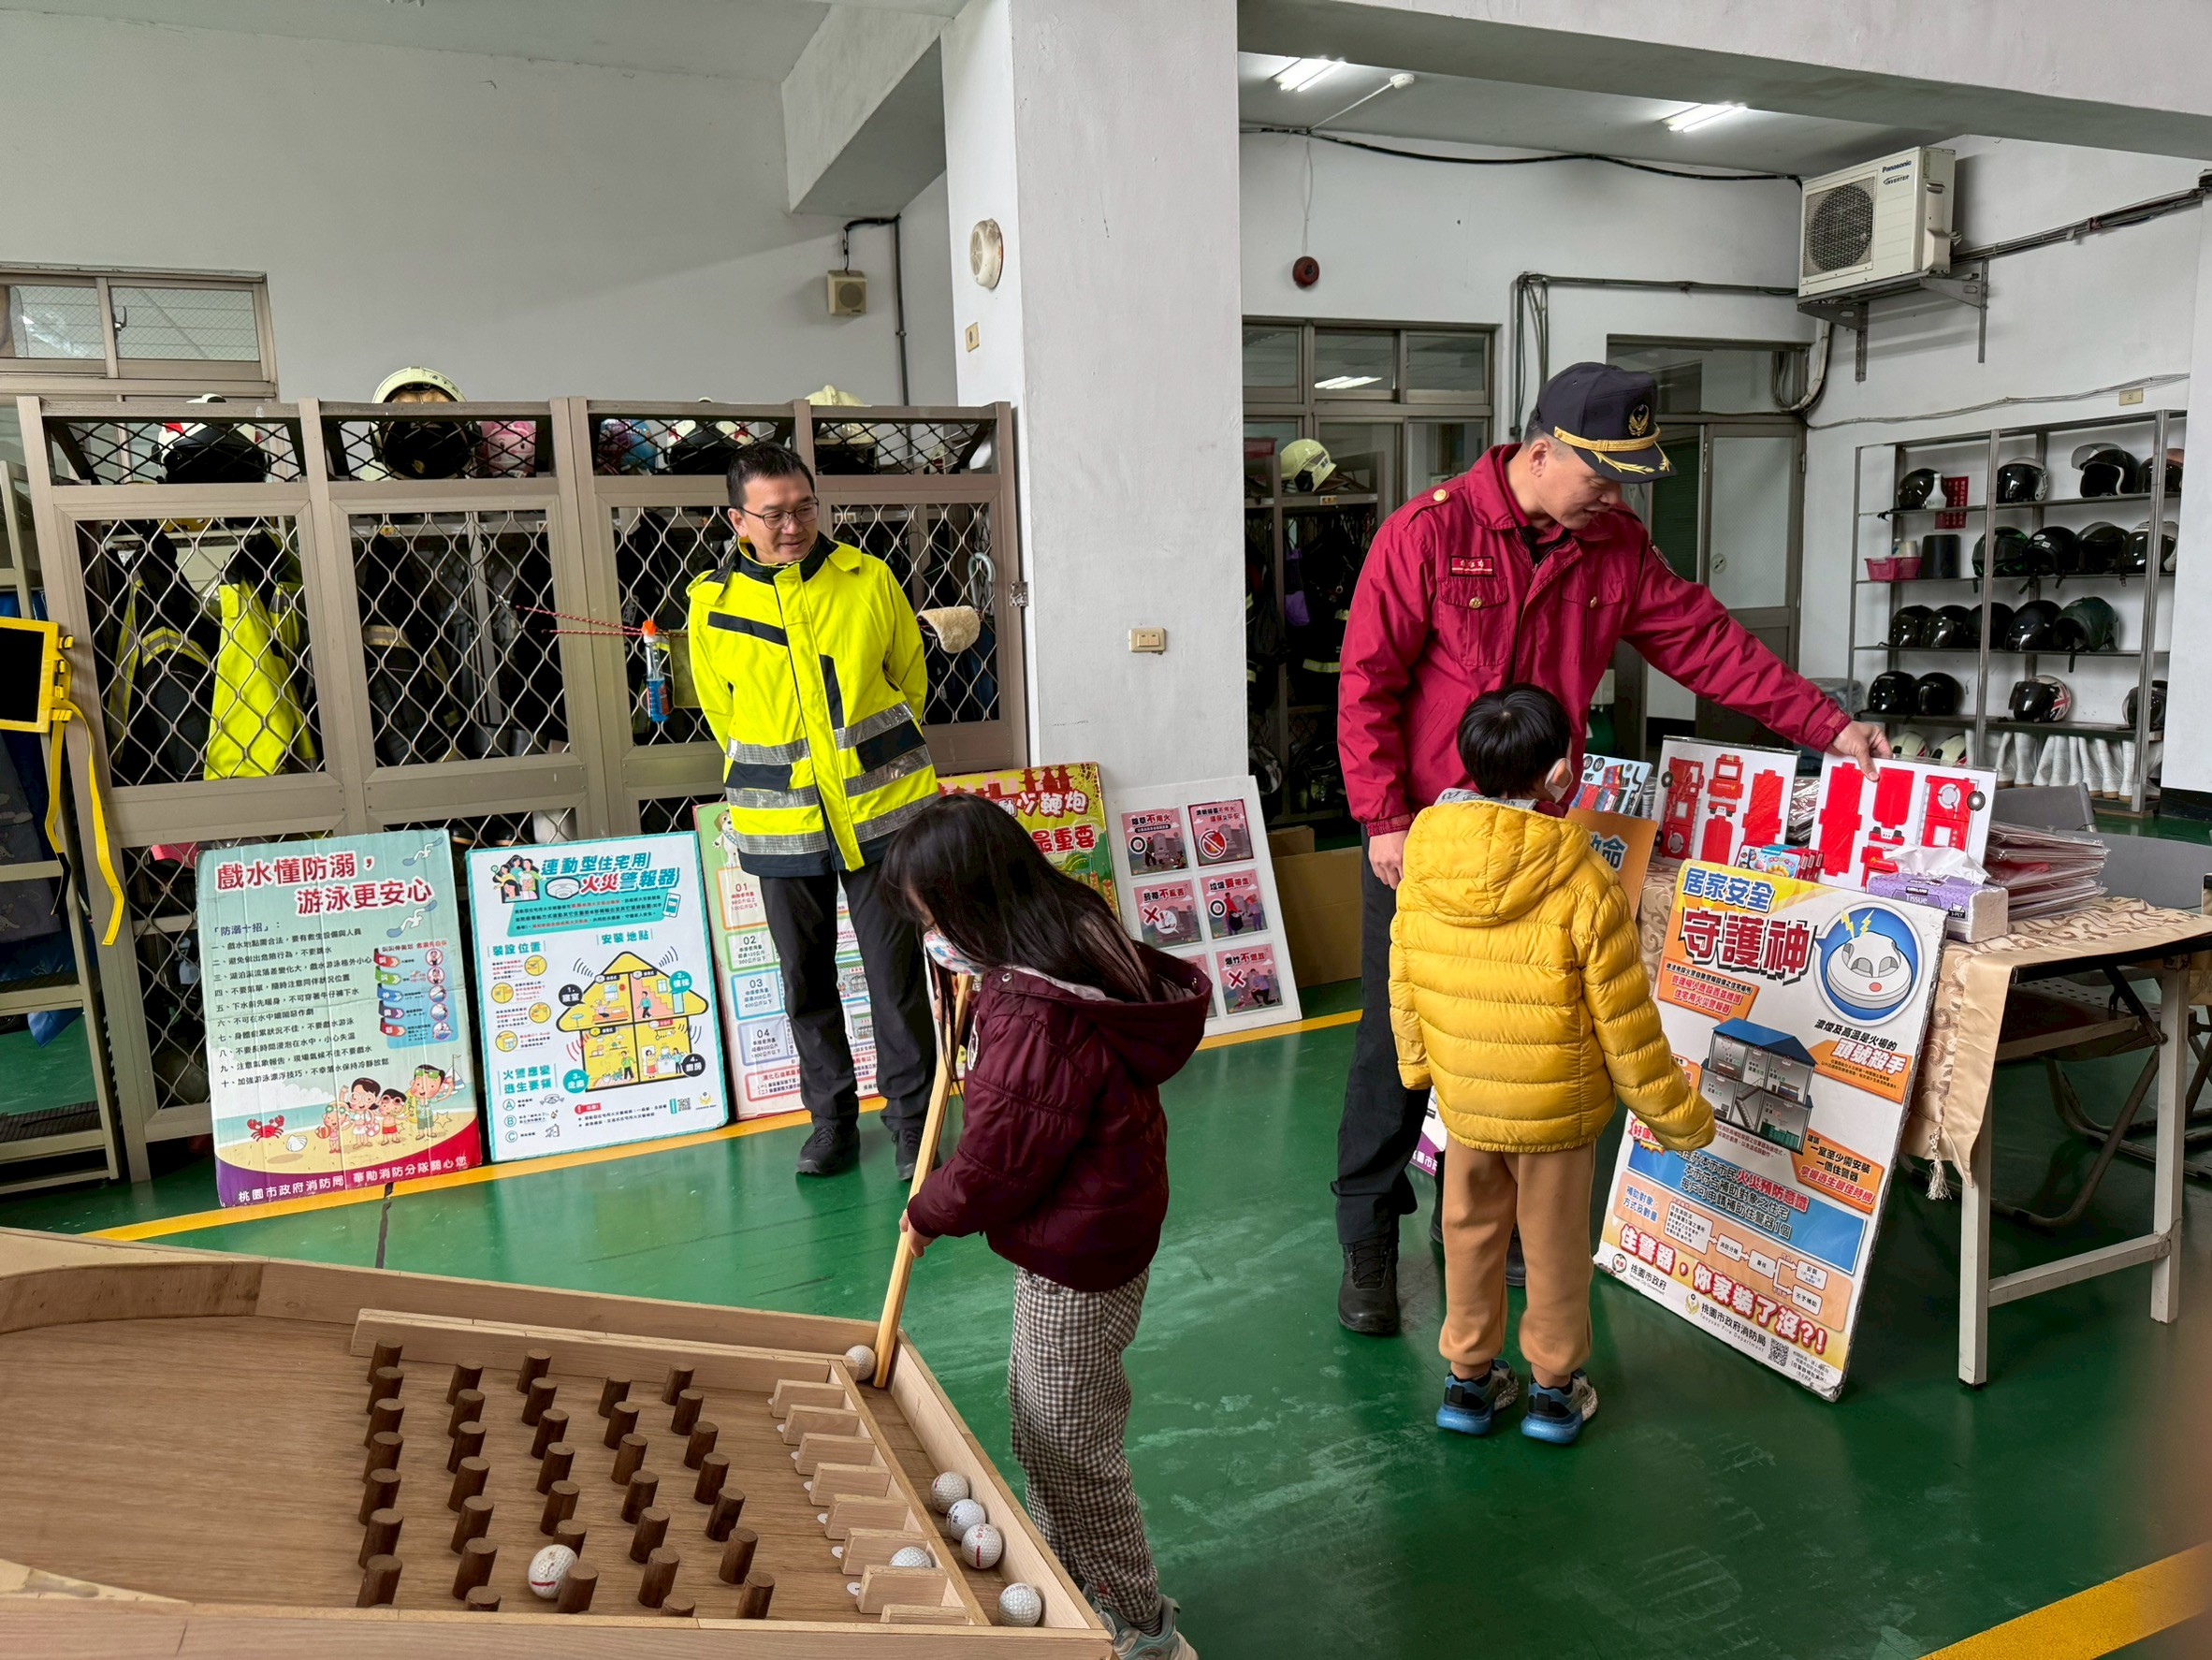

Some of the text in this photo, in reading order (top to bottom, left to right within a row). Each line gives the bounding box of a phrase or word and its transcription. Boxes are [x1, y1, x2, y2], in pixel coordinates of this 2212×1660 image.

[1882, 159, 1912, 173] Panasonic
[1885, 175, 1910, 185] INVERTER
[217, 852, 375, 890] 戲水懂防溺，
[541, 852, 650, 876] 連動型住宅用
[580, 867, 679, 894] 火災警報器
[735, 883, 748, 892] 01
[1683, 867, 1774, 911] 居家安全
[297, 879, 432, 914] 游泳更安心
[1906, 895, 1928, 905] Tissue
[602, 930, 649, 944] 安裝地點
[743, 936, 757, 945] 02
[1681, 909, 1813, 979] 守護神
[749, 979, 763, 988] 03
[756, 1029, 770, 1039] 04
[1814, 1018, 1898, 1052] 濃煙及高溫是火場的
[1831, 1039, 1907, 1074] 頭號殺手
[1811, 1145, 1870, 1173] 一室至少需安裝
[238, 1174, 345, 1202] 桃園市政府消防局
[1684, 1164, 1790, 1220] 本市符合補助對象之住宅
[1623, 1197, 1658, 1222] 方式及數量
[1681, 1177, 1792, 1239] 每戶可申請補助住警器1個
[1630, 1264, 1667, 1291] 桃園市政府
[1701, 1303, 1767, 1347] 桃園市政府消防局
